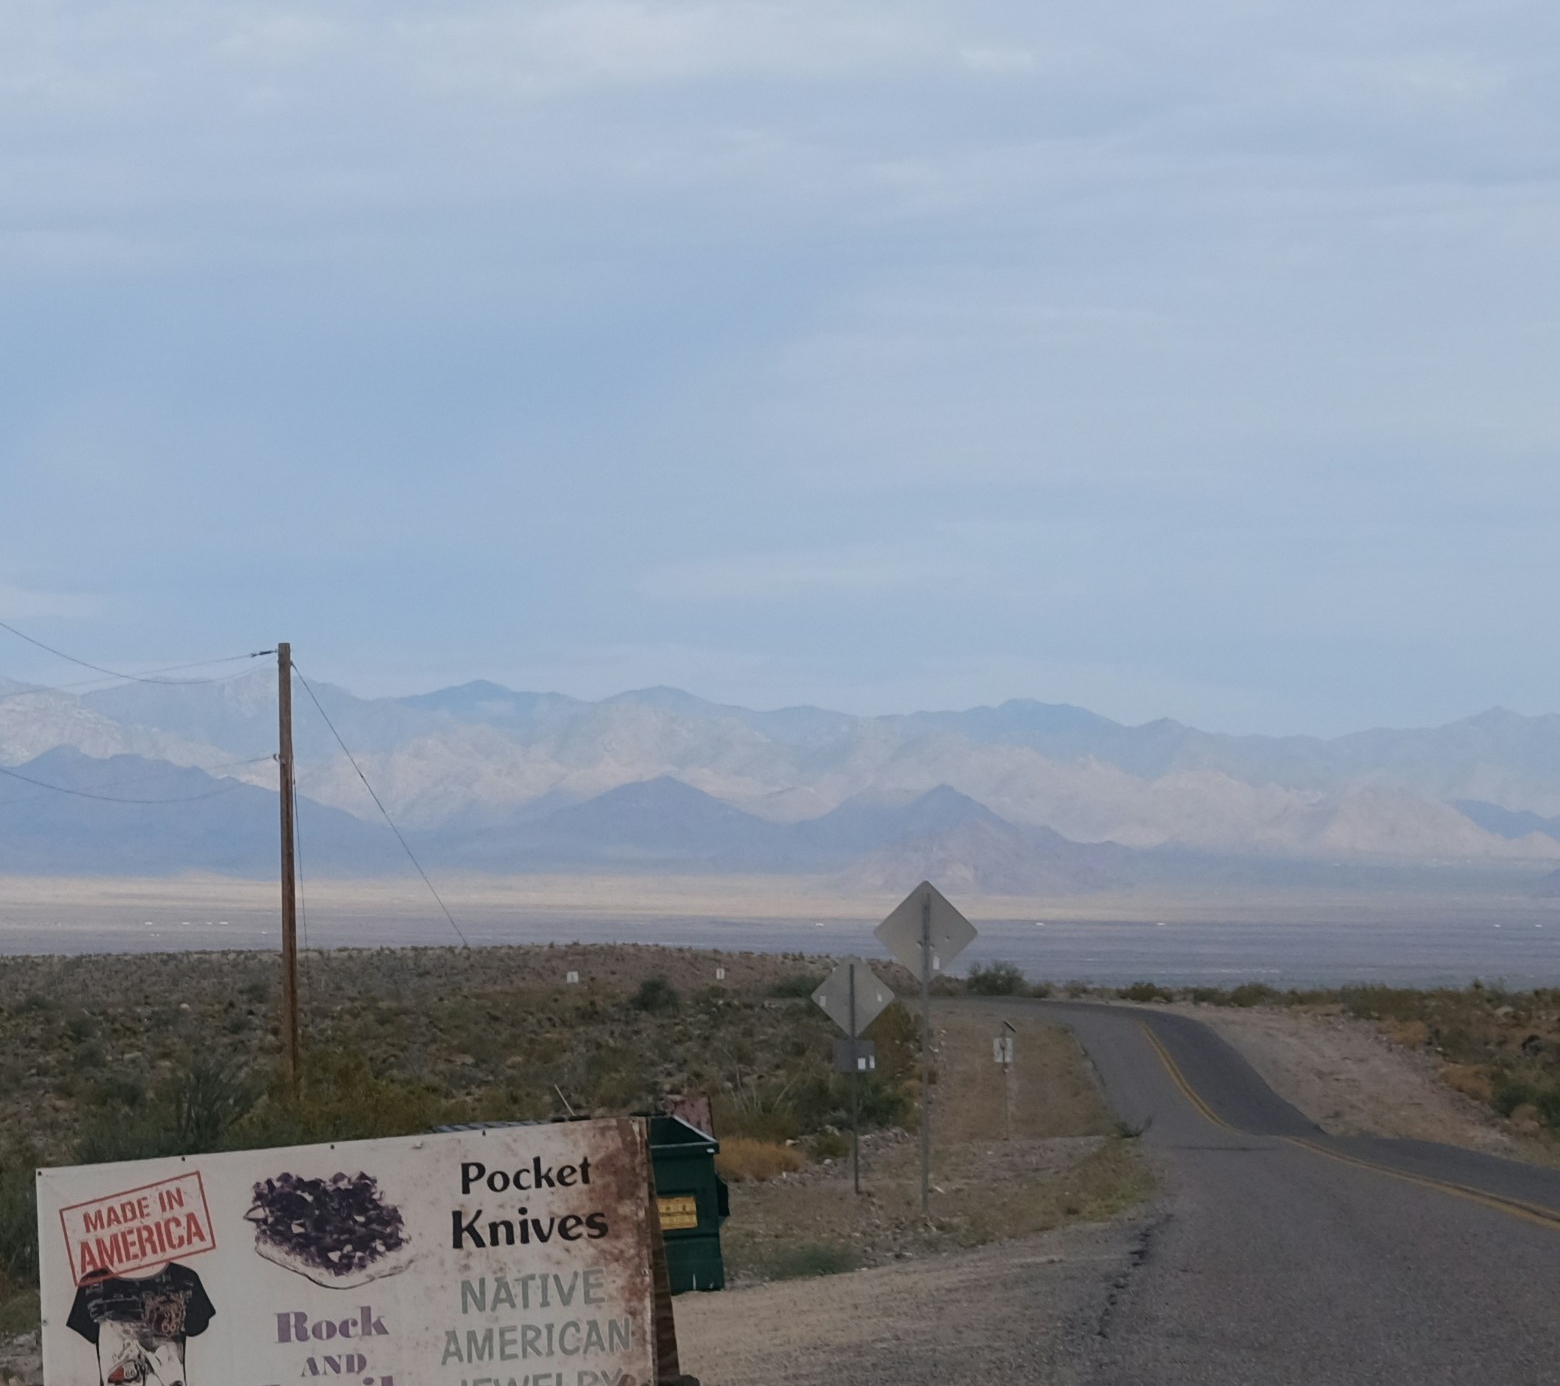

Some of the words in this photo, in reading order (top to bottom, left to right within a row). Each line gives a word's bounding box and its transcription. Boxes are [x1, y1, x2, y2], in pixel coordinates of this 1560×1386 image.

[461, 1156, 592, 1195] Pocket
[83, 1197, 151, 1233] MADE
[158, 1187, 184, 1213] IN
[452, 1207, 609, 1249] Knives
[80, 1212, 207, 1275] AMERICA
[461, 1268, 606, 1314] NATIVE
[274, 1306, 389, 1343] Rock
[441, 1317, 631, 1366] AMERICAN
[300, 1353, 367, 1377] AND
